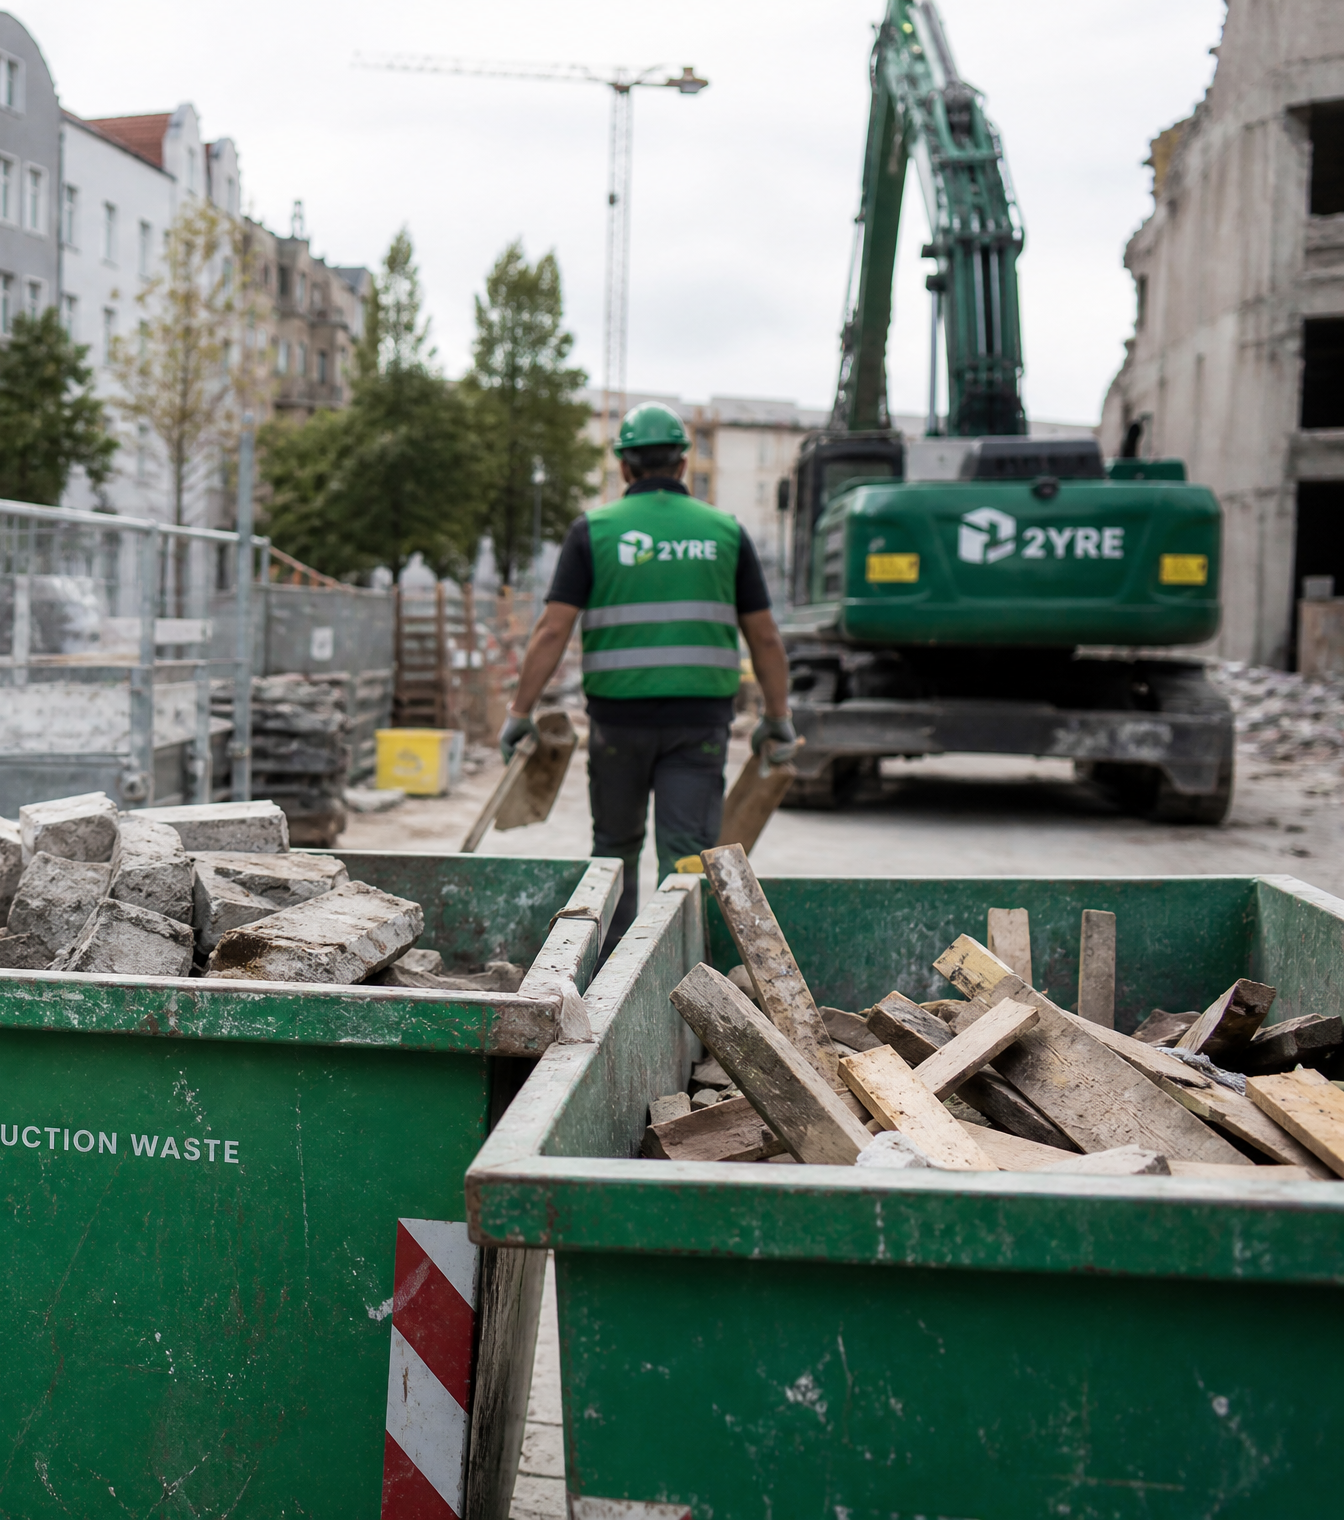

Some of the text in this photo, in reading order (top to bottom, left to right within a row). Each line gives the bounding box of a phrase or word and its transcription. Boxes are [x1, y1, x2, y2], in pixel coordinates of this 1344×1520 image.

[657, 539, 718, 561] 2YRE
[1021, 526, 1124, 559] 2YRE
[130, 1133, 240, 1164] WASTE
